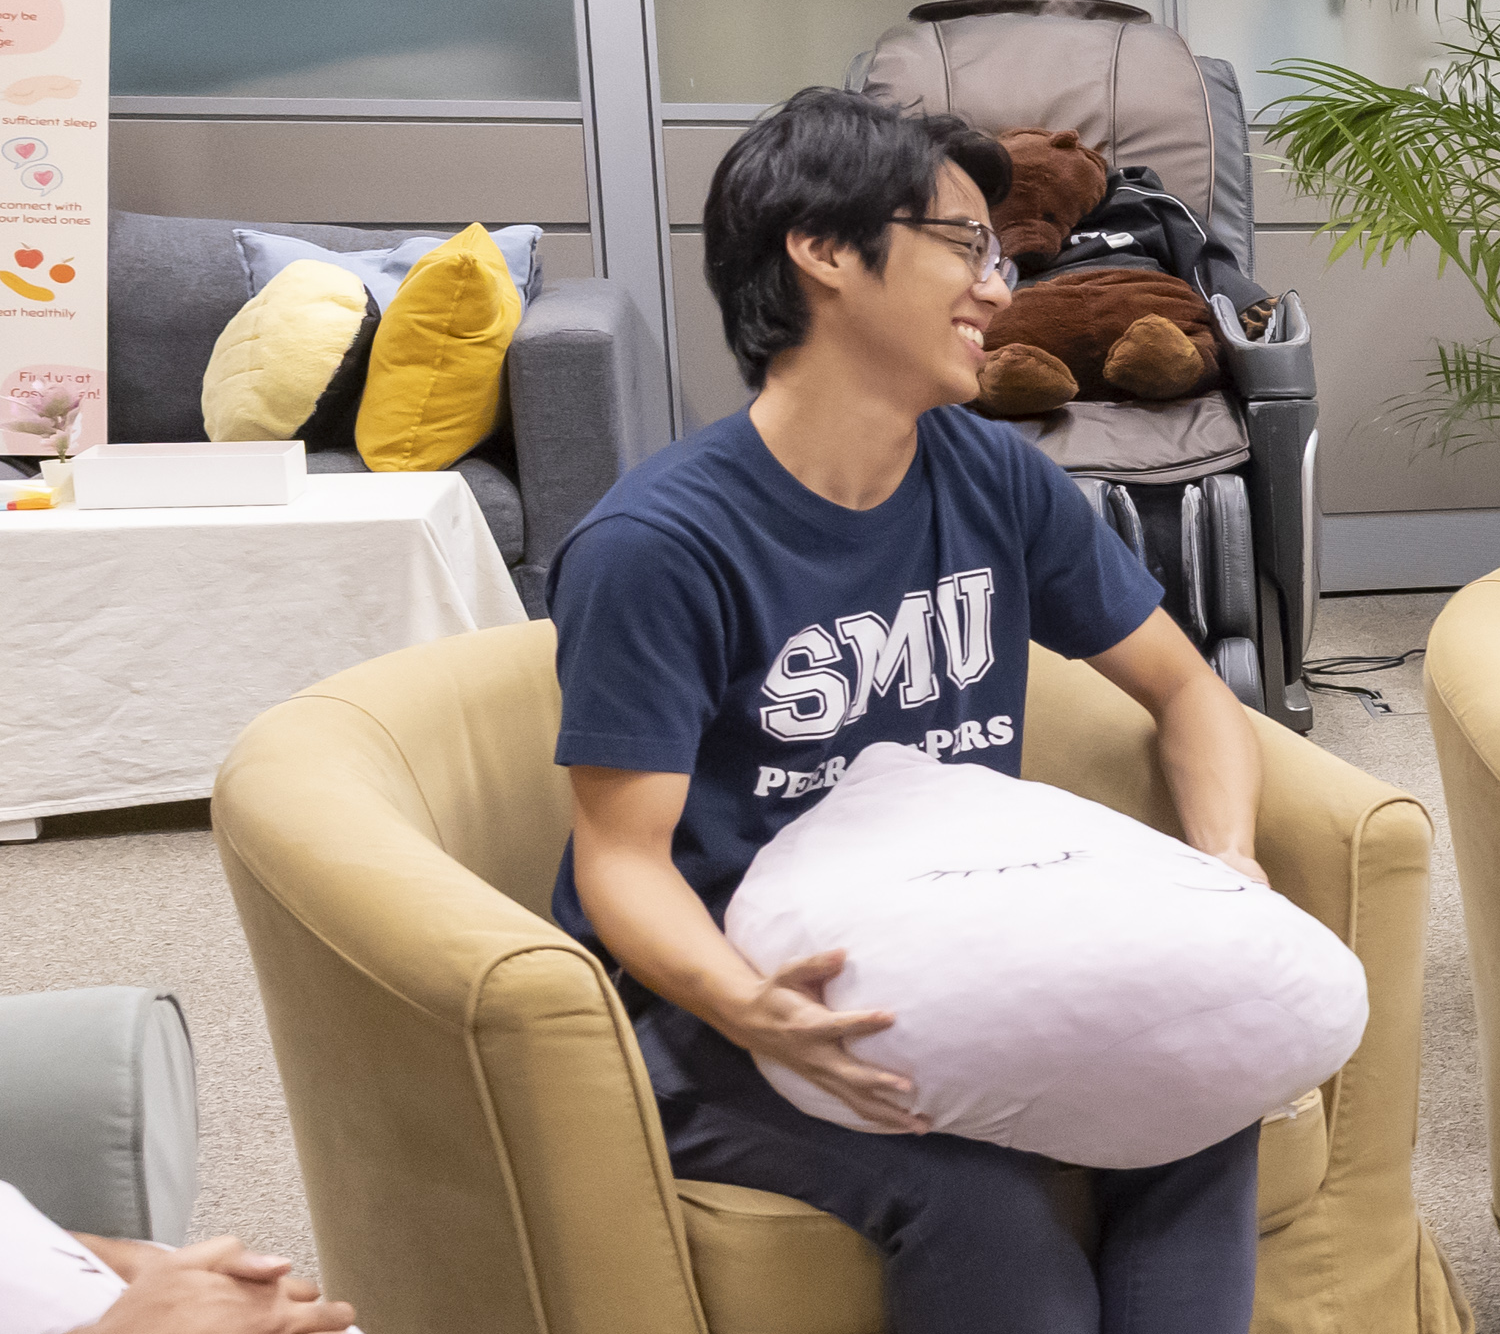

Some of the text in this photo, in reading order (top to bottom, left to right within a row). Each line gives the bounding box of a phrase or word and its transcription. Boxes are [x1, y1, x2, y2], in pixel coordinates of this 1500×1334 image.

[21, 11, 38, 21] be
[2, 115, 97, 130] sufficient sleep
[0, 201, 82, 211] connect with
[23, 214, 57, 224] loved
[60, 217, 91, 225] ones
[0, 308, 76, 320] eat healthily
[75, 373, 91, 384] at
[759, 567, 995, 742] SMU
[753, 755, 847, 799] PEER
